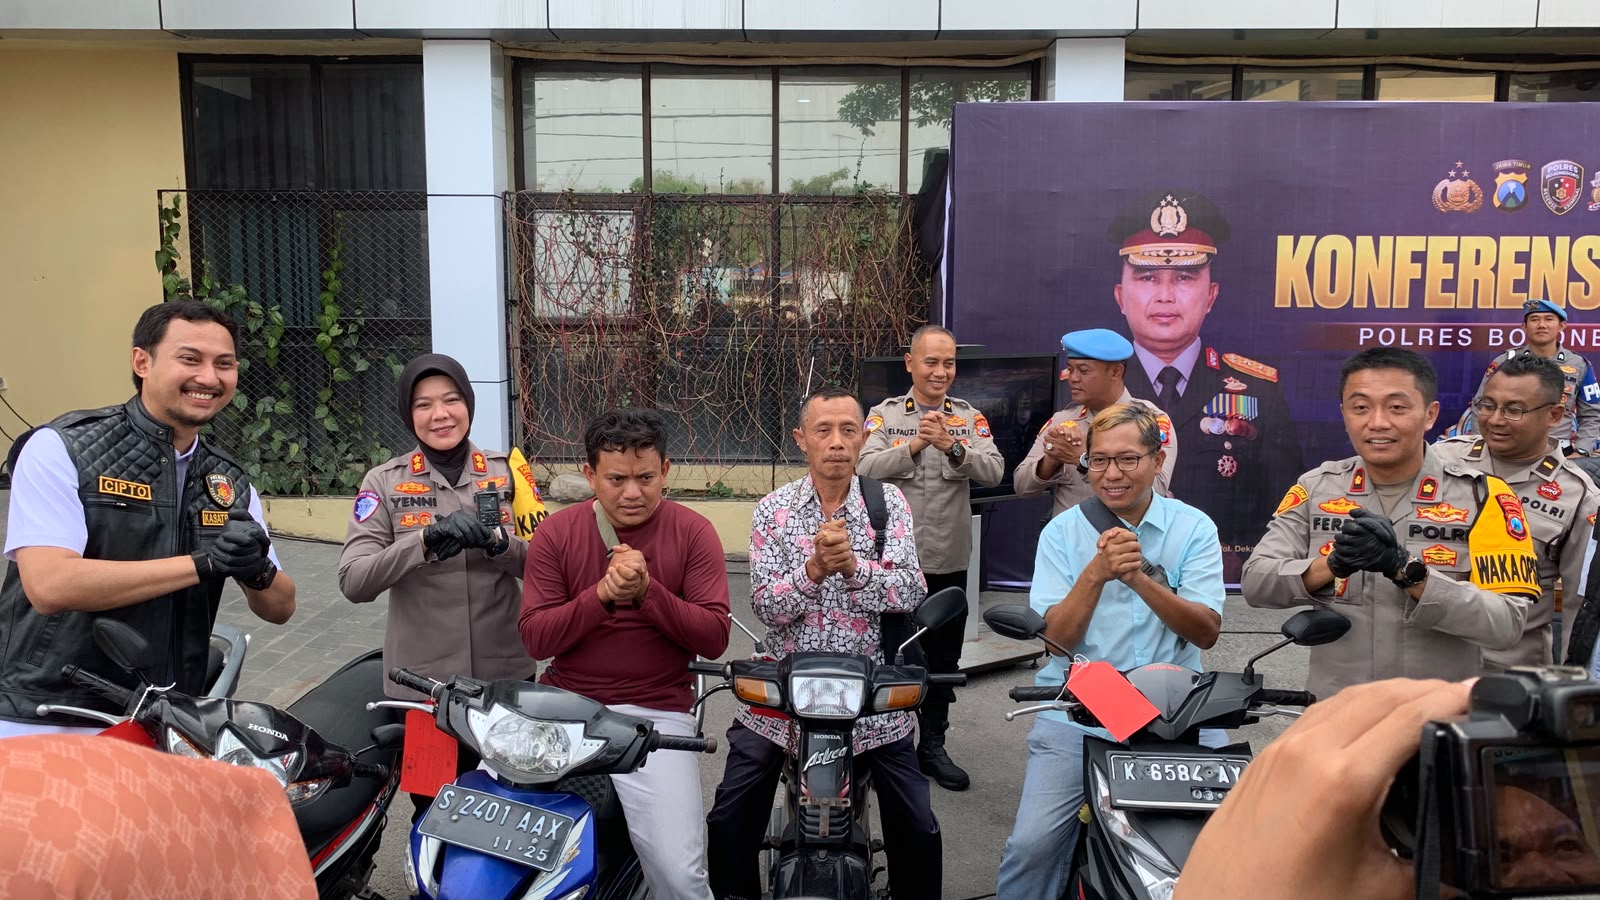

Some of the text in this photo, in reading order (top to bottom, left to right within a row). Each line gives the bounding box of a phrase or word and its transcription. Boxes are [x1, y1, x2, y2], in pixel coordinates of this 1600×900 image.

[1496, 161, 1531, 170] JAWA TIMUR
[1547, 164, 1578, 174] POLRES
[1274, 235, 1600, 309] KONFERENS
[1358, 328, 1473, 346] POLRES
[948, 428, 970, 436] OLRI
[104, 480, 147, 497] CIPTO
[391, 497, 437, 508] YENNI
[247, 722, 289, 742] HONDA
[1123, 762, 1136, 780] K
[438, 790, 564, 841] S 2401 AAX
